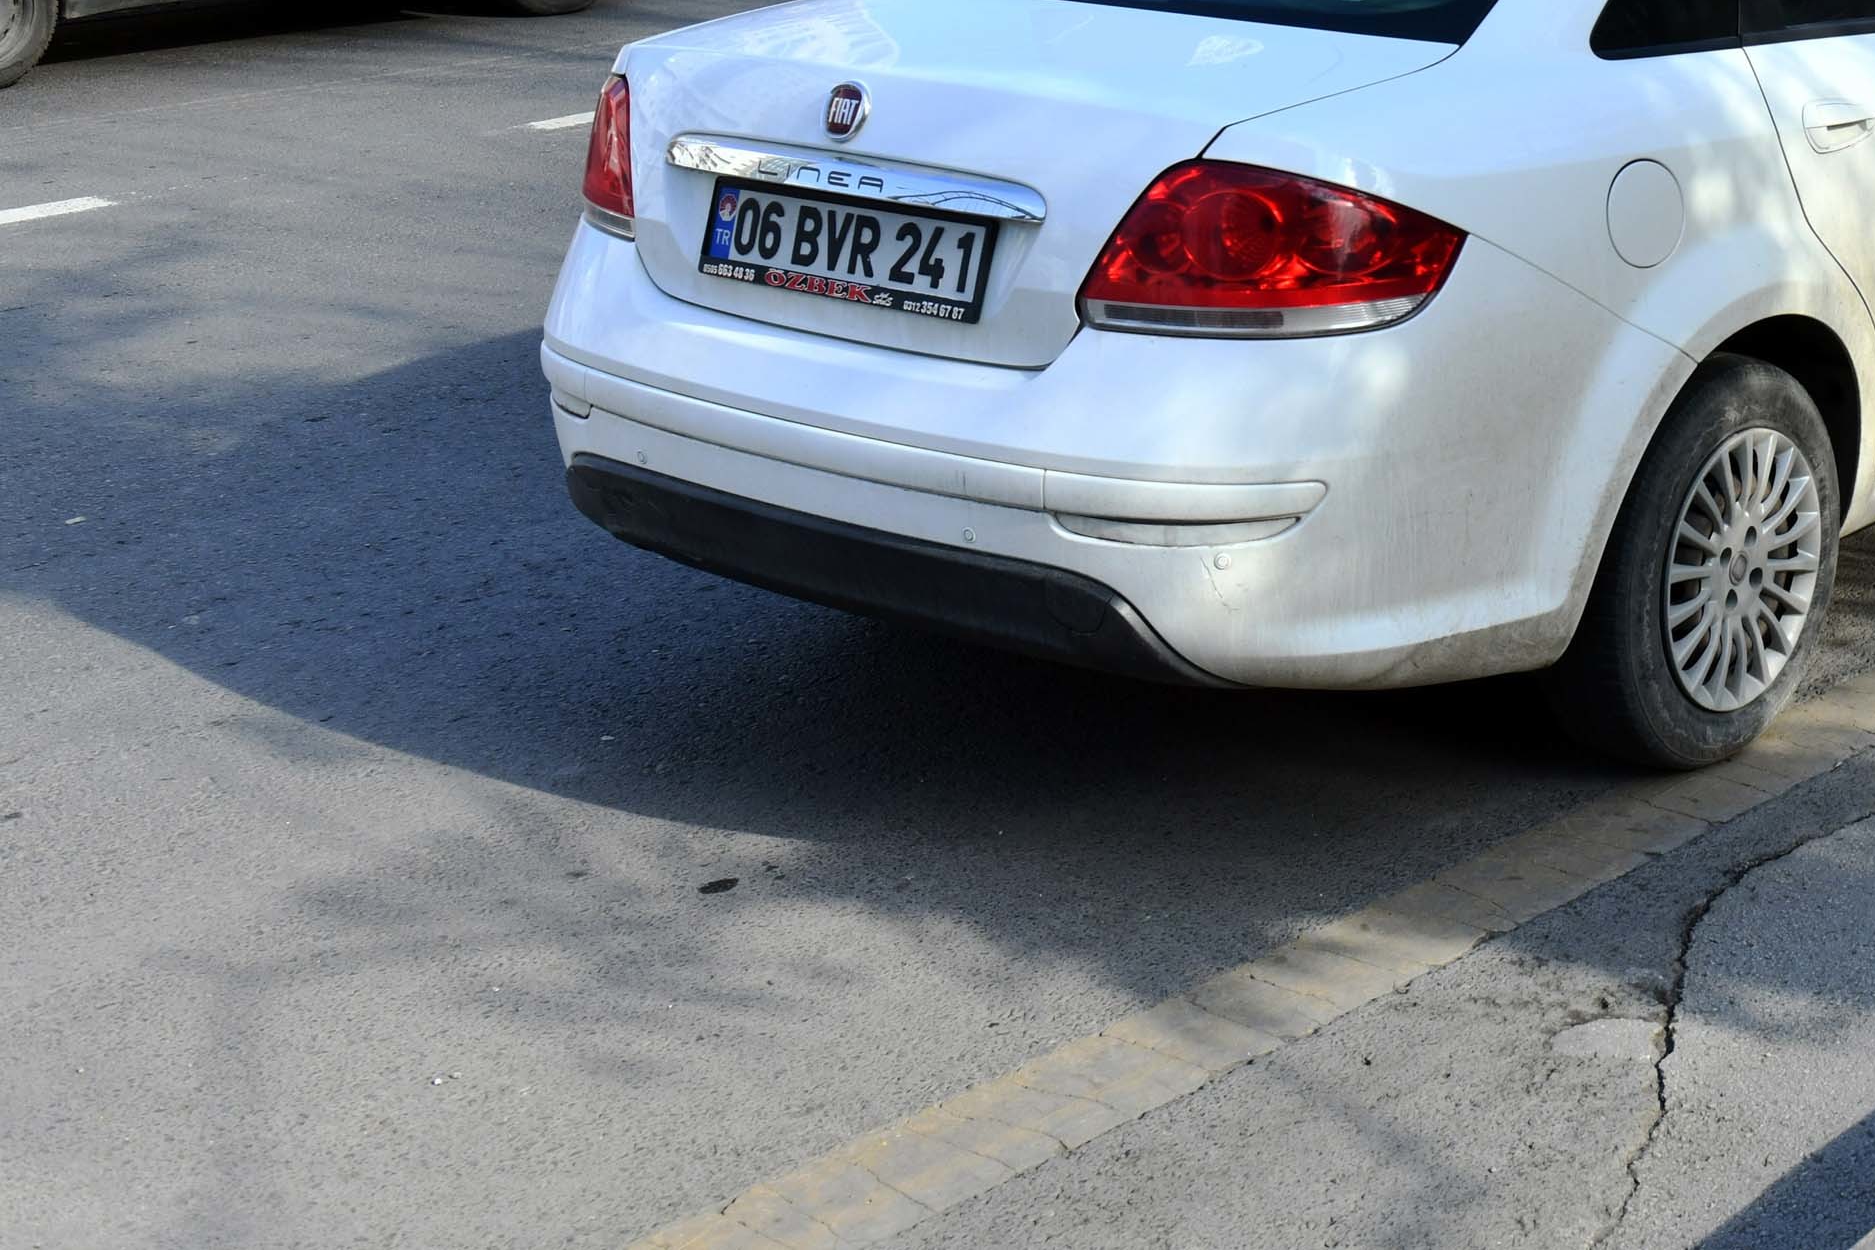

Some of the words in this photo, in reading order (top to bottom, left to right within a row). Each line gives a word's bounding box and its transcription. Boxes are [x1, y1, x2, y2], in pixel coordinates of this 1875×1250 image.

[828, 97, 859, 126] FIAT
[756, 160, 885, 194] LINEA
[714, 227, 731, 246] TR
[733, 196, 785, 261] 06
[790, 204, 881, 279] BVR
[888, 220, 977, 295] 241
[764, 267, 873, 304] ÖZBEK
[920, 301, 939, 316] 354
[938, 304, 952, 317] 67
[951, 306, 965, 320] 87
